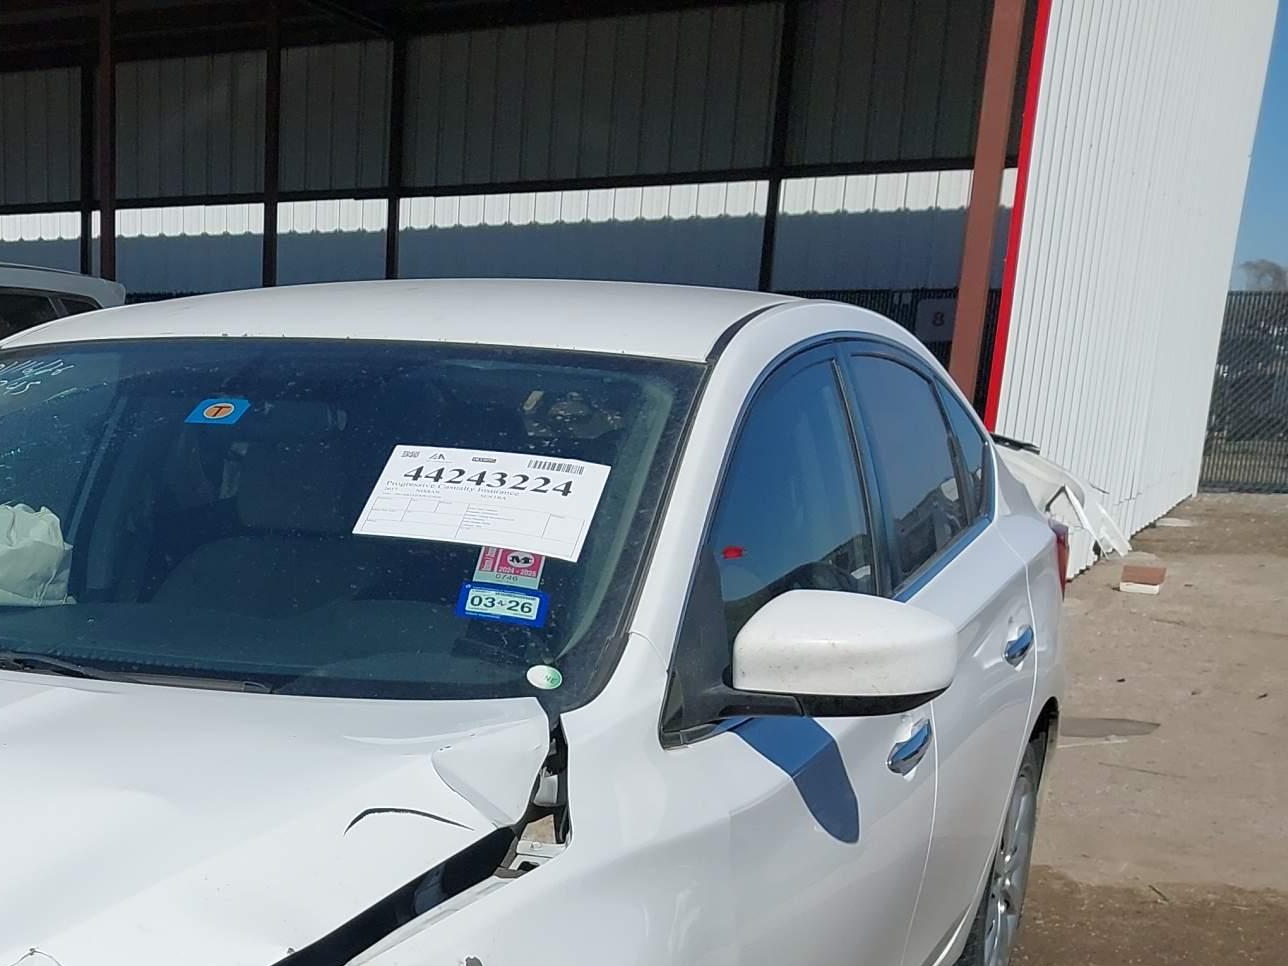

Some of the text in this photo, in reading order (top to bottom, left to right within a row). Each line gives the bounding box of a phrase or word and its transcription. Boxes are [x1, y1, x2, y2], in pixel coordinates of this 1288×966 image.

[932, 311, 945, 327] 8
[212, 405, 232, 417] T
[386, 480, 520, 497] Progressive Casualty Insurance
[403, 465, 573, 497] 44243224
[509, 554, 533, 564] M
[470, 595, 532, 614] 03 26
